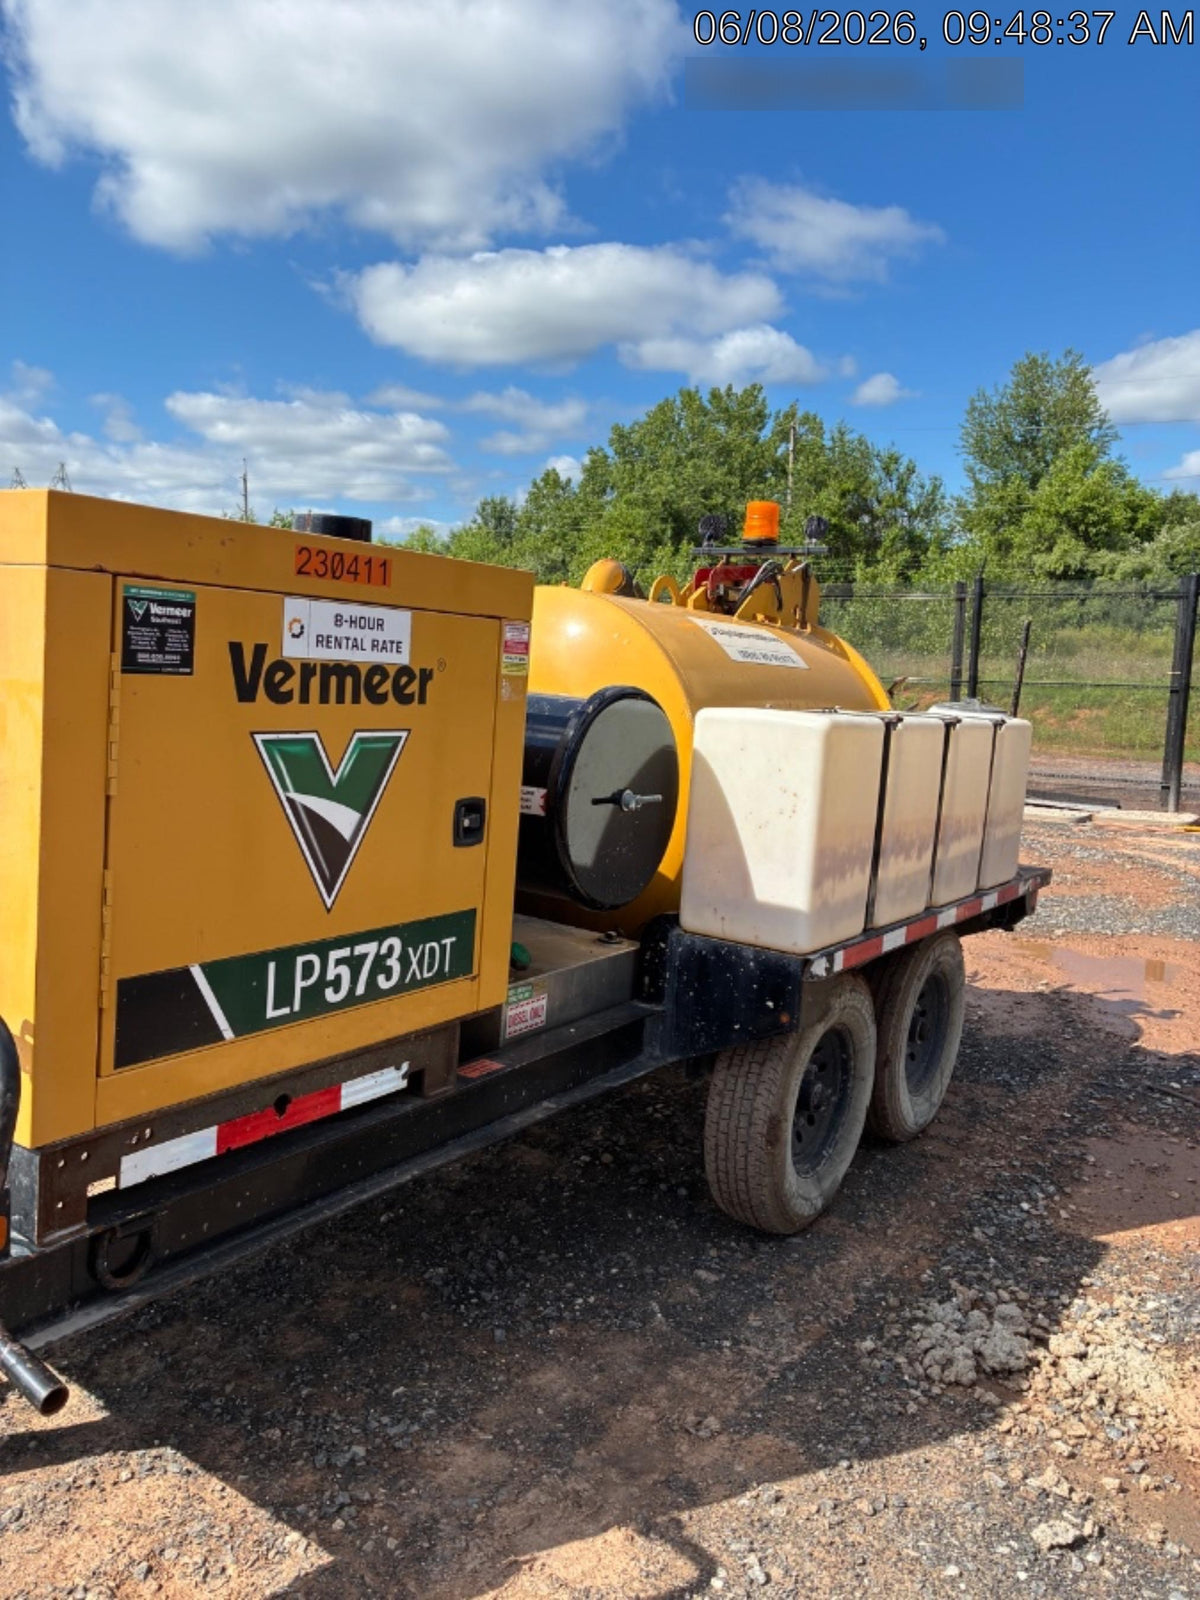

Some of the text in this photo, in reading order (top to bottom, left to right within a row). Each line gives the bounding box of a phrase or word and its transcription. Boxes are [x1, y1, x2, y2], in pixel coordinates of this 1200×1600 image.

[296, 546, 388, 586] 230411
[149, 602, 193, 617] Vermeer
[333, 613, 385, 632] 8-HOUR
[315, 634, 403, 654] RENTAL RATE
